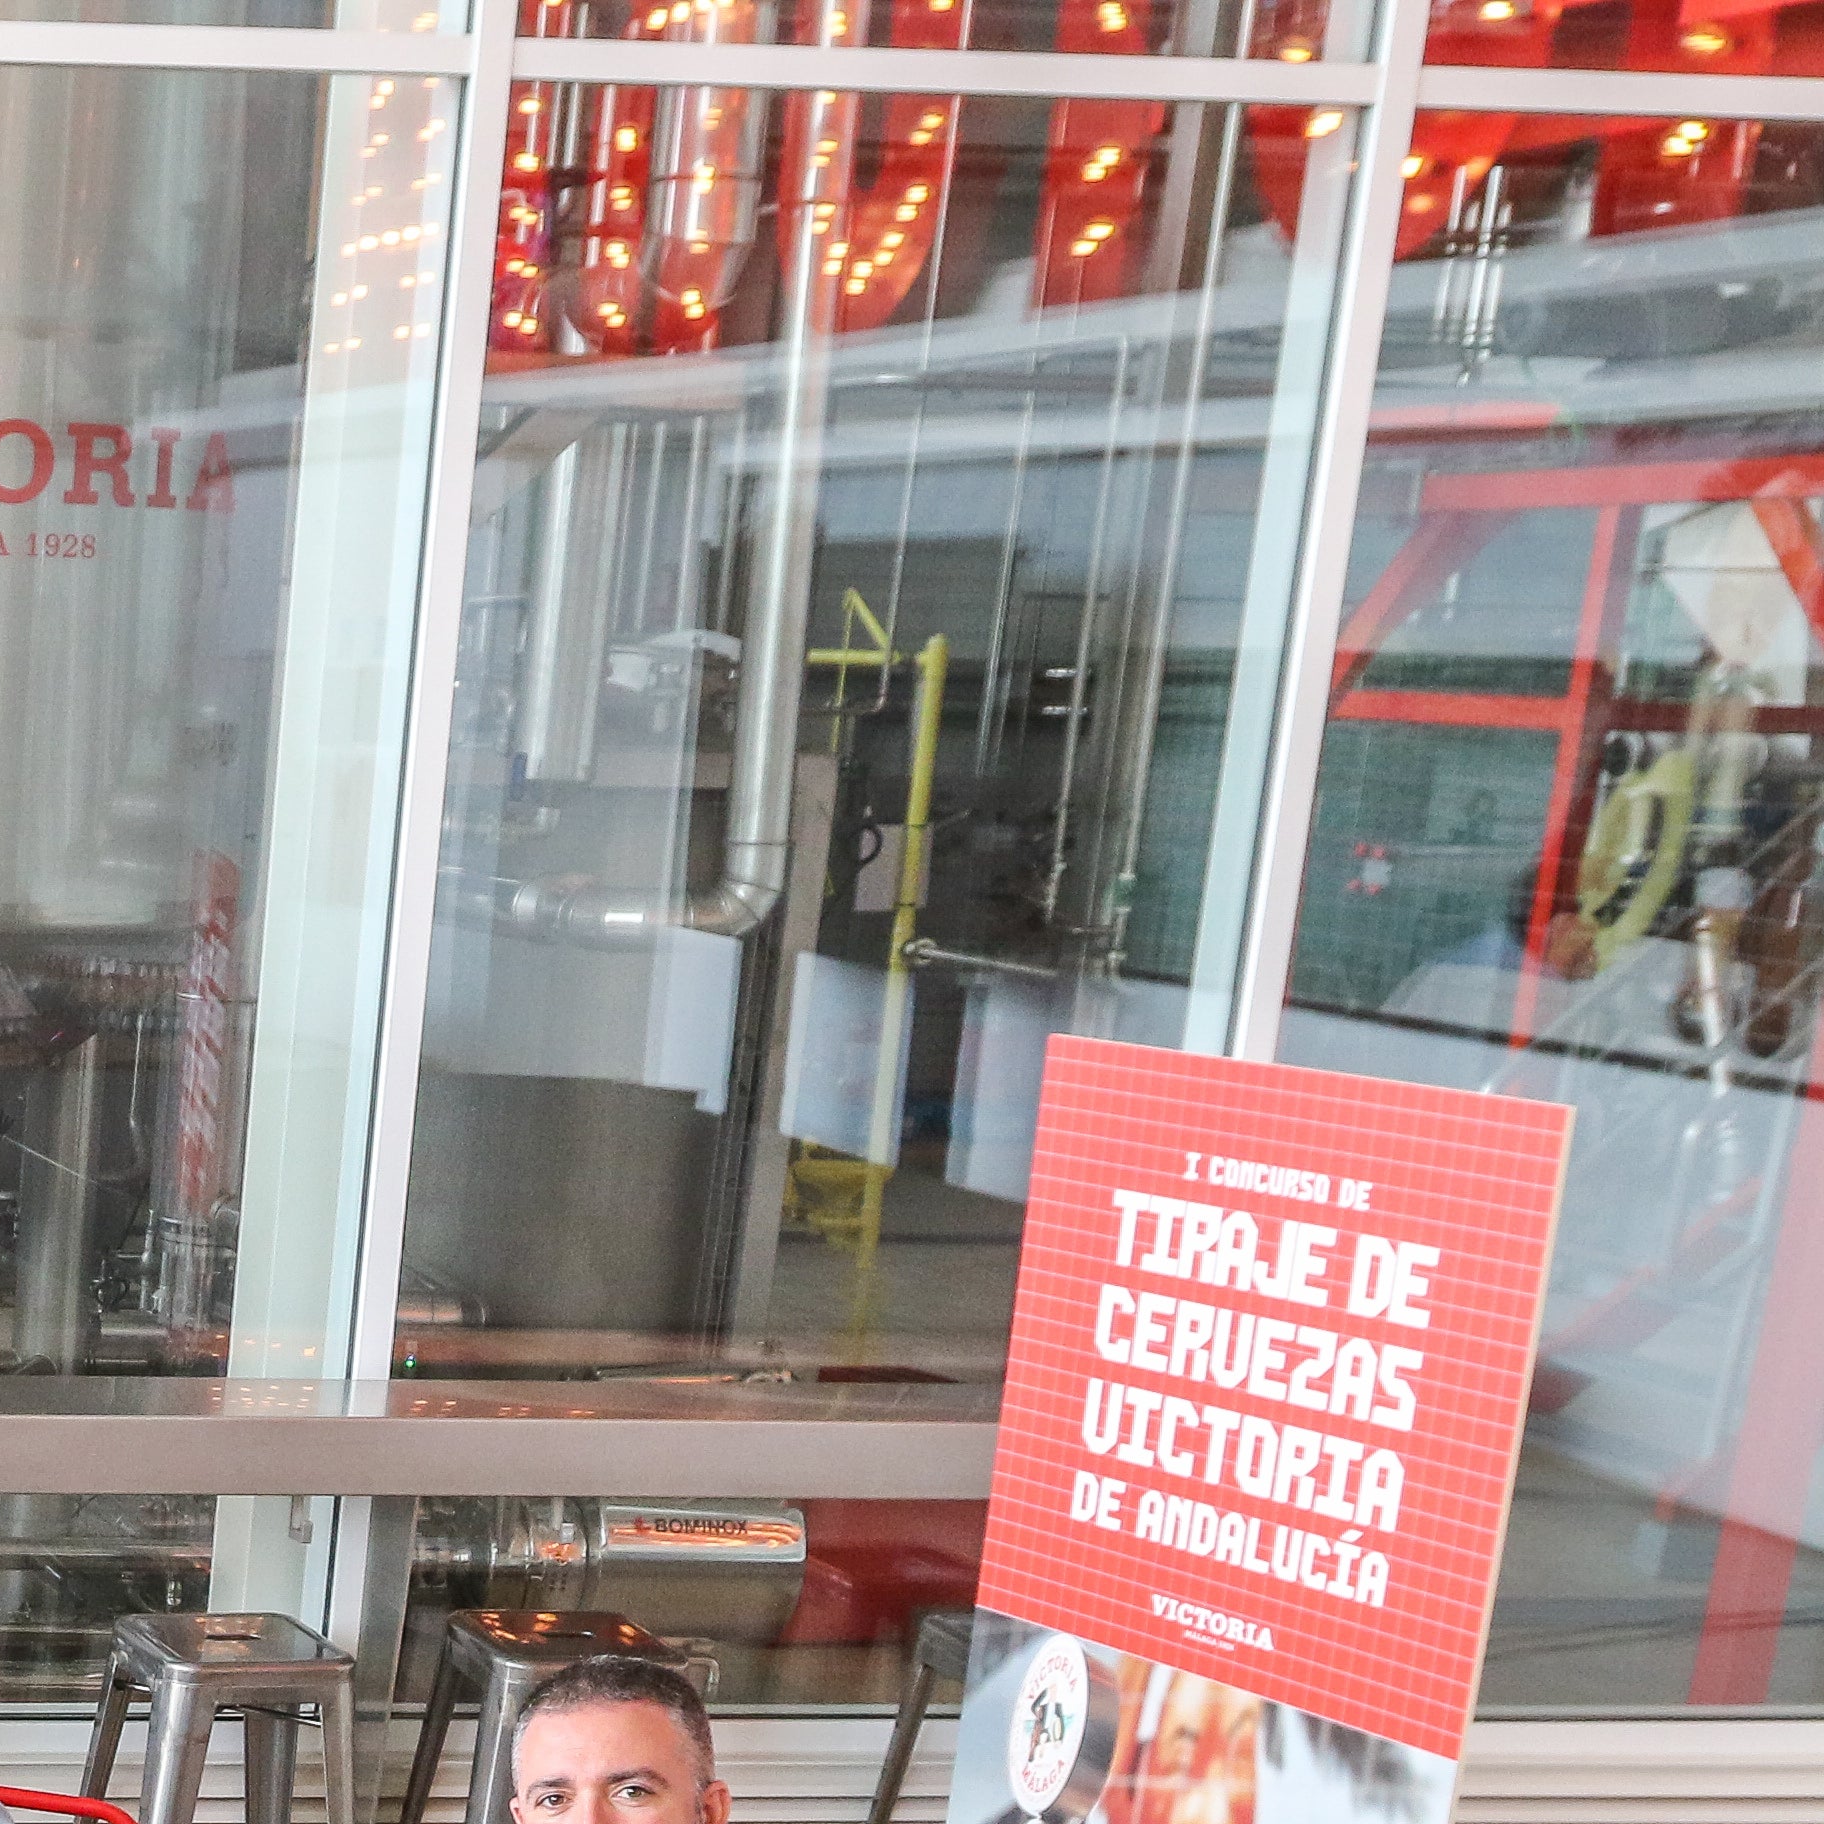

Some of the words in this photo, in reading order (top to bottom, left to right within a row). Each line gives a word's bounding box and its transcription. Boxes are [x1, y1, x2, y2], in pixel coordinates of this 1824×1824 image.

[27, 533, 96, 558] 1928
[1183, 1152, 1202, 1181] I
[1209, 1156, 1330, 1204] CONCURSO
[1339, 1179, 1373, 1211] DE
[1113, 1188, 1339, 1308] TIRAJE
[1347, 1233, 1440, 1330] DE
[1095, 1283, 1424, 1432] CERVEZAS
[1082, 1377, 1405, 1534] VICTORIA
[1070, 1469, 1126, 1532] DE
[1136, 1490, 1389, 1609] ANDALUCÍA
[1152, 1593, 1275, 1651] VICTORIA
